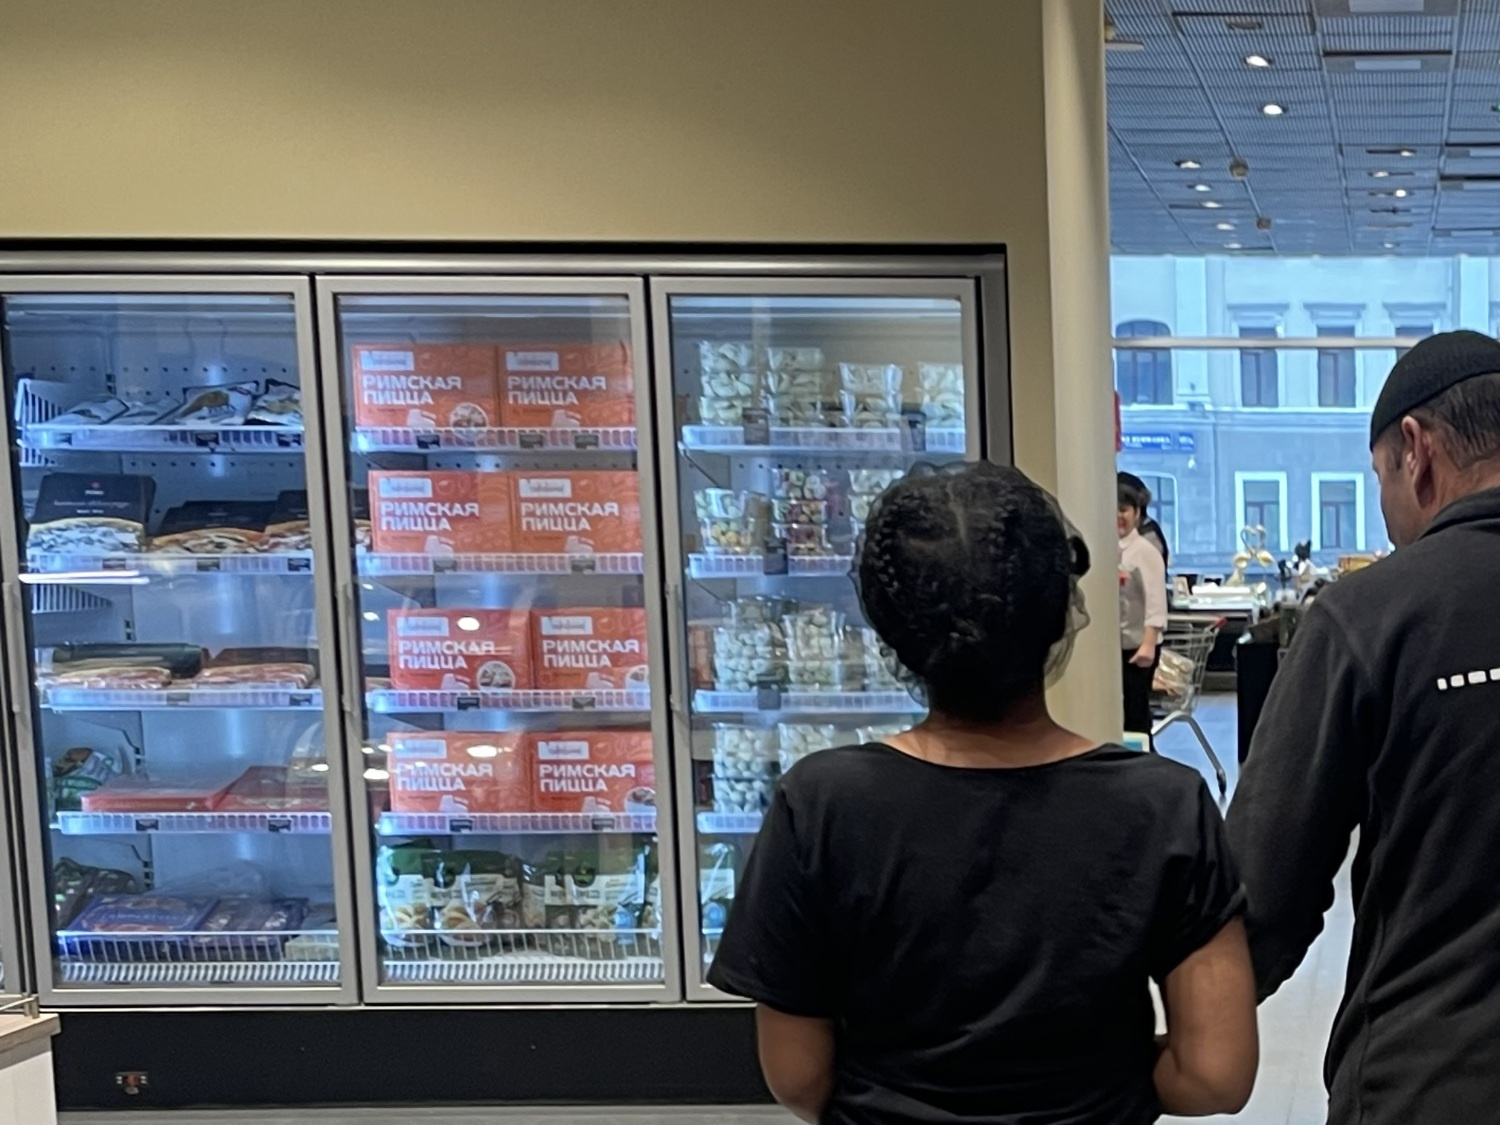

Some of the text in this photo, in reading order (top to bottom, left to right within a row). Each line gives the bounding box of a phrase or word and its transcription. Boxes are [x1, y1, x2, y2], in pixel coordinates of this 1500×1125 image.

[362, 375, 462, 390] РИМСКАЯ
[507, 375, 606, 390] РИМСКАЯ
[364, 390, 434, 405] ПИЦЦА
[508, 391, 578, 405] ПИЦЦА
[380, 502, 479, 516] РИМСКАЯ
[520, 502, 619, 516] РИМСКАЯ
[381, 517, 451, 531] ПИЦЦА
[521, 517, 591, 531] ПИЦЦА
[399, 641, 495, 654] РИМСКАЯ
[542, 639, 640, 653] РИМСКАЯ
[400, 655, 468, 670] ПИЦЦА
[543, 653, 612, 668] ПИЦЦА
[396, 763, 494, 777] РИМСКАЯ
[539, 764, 636, 777] РИМСКАЯ
[397, 777, 465, 791] ПИЦЦА
[540, 778, 608, 792] ПИЦЦА
